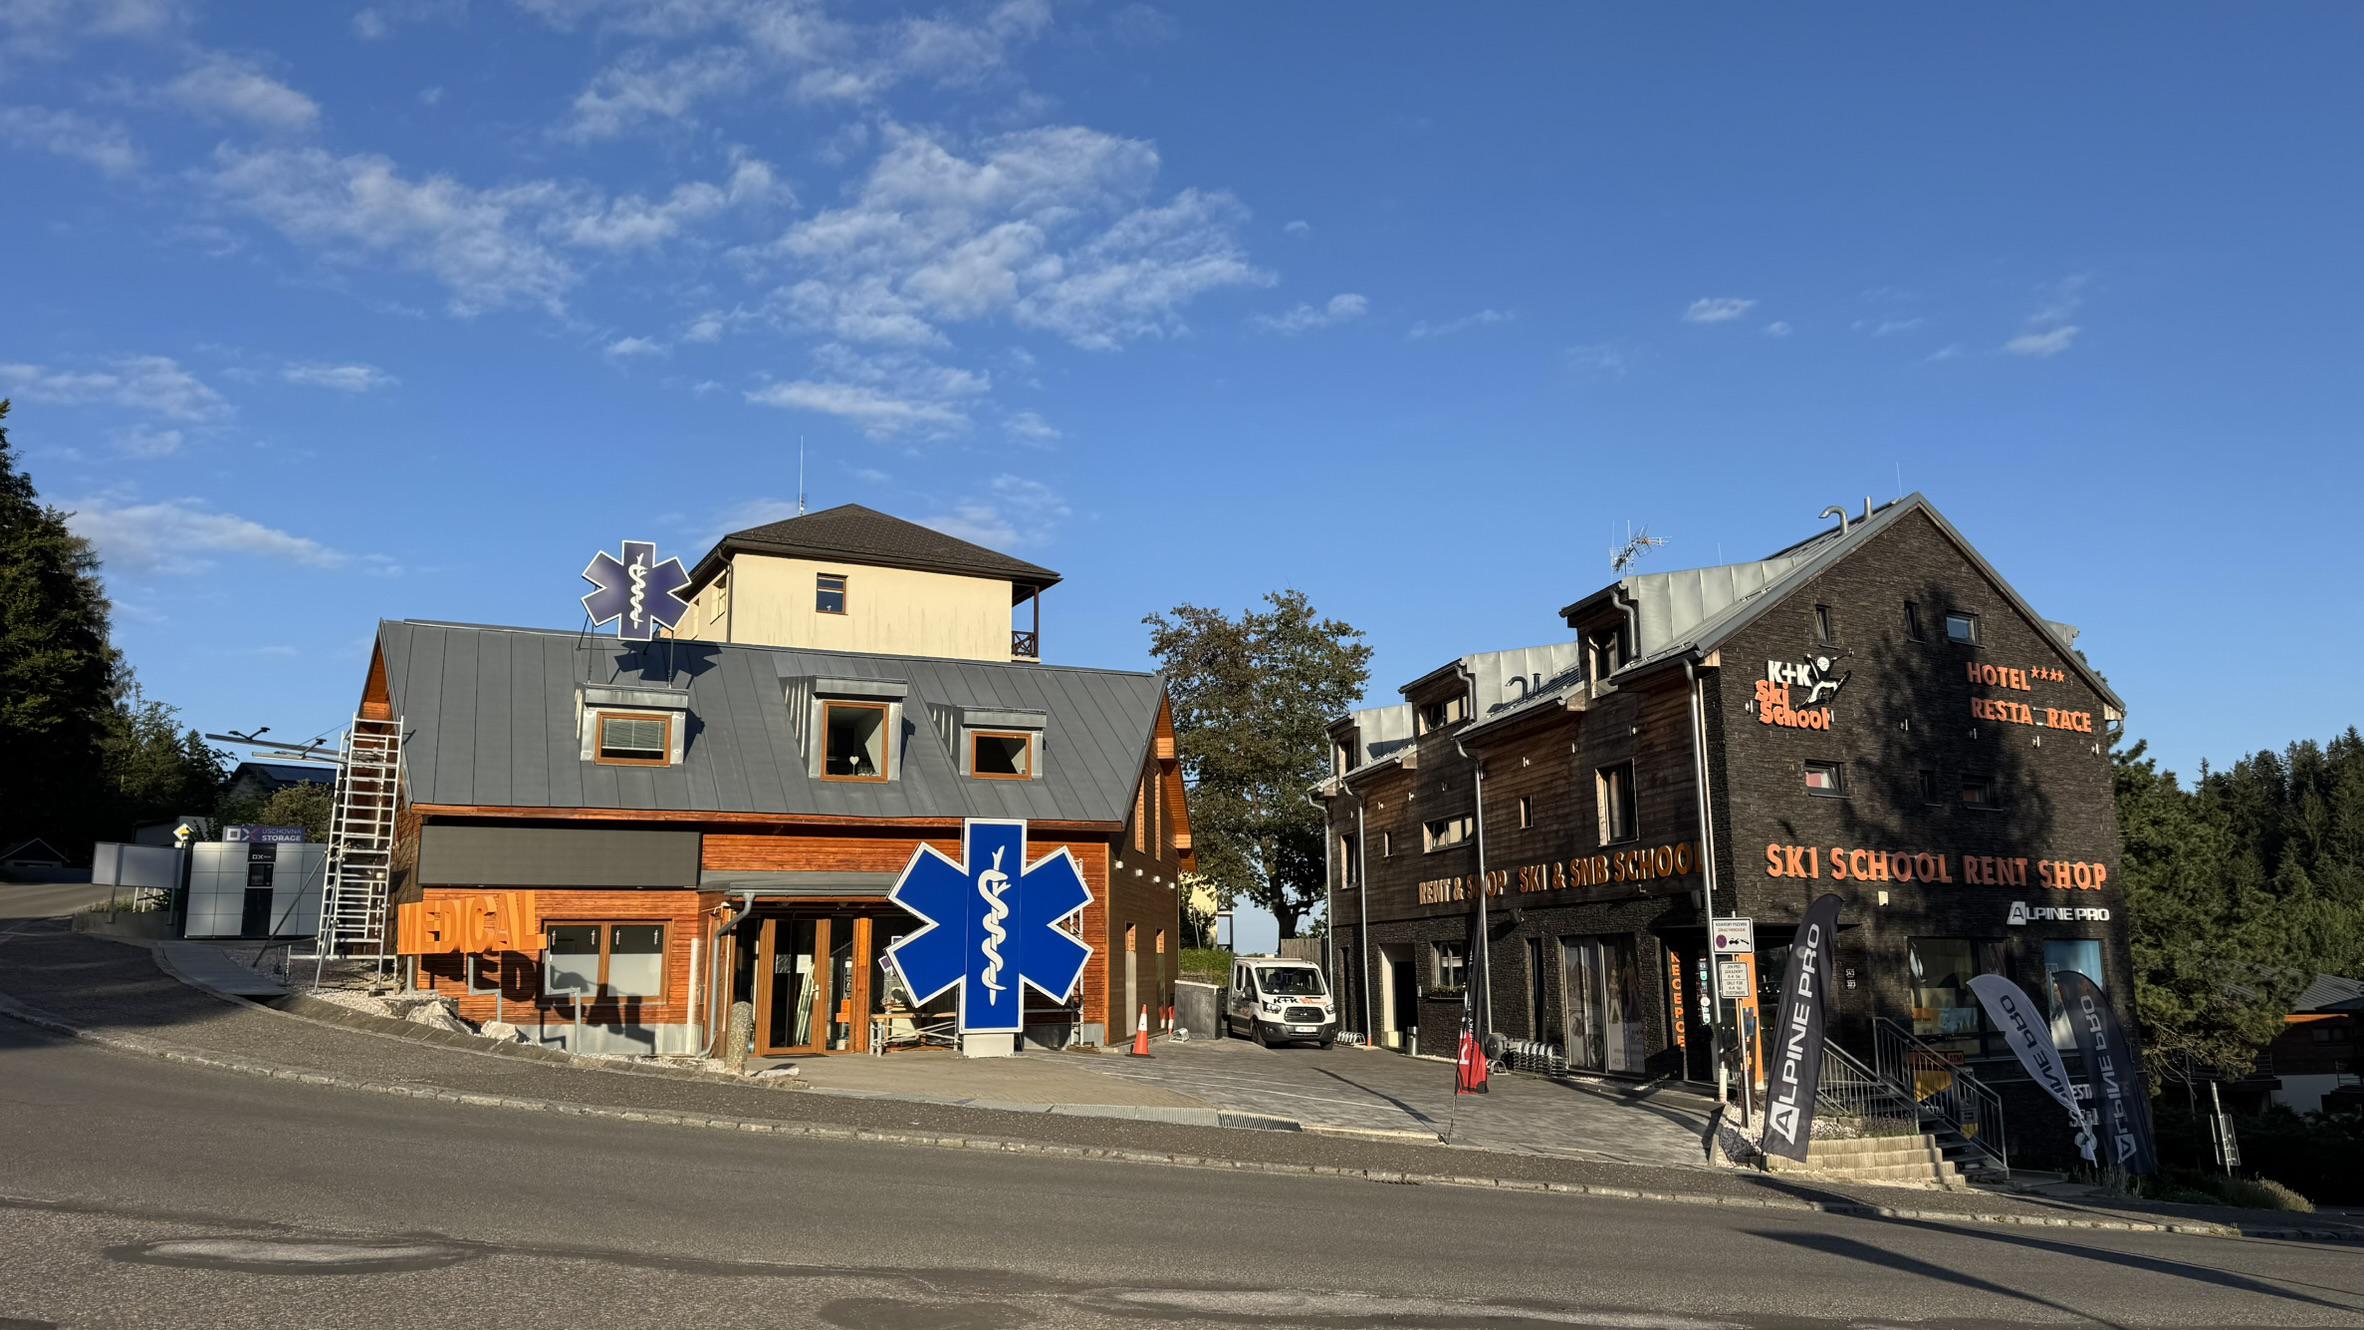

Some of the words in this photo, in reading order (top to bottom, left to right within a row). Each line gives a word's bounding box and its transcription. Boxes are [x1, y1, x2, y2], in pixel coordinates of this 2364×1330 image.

[1768, 660, 1812, 687] K+K
[1967, 662, 2031, 691] HOTEL
[1418, 878, 1451, 904] RENT
[1453, 877, 1464, 900] &
[1519, 864, 1548, 894] SKI
[1552, 862, 1566, 889] &
[1570, 855, 1609, 887] SNB
[1766, 844, 1819, 879] SKI
[1830, 848, 1952, 883] SCHOOL
[1963, 855, 2028, 886] RENT
[2039, 860, 2107, 890] SHOP
[2007, 901, 2074, 925] ALPINE
[2075, 908, 2110, 921] PRO
[1769, 1002, 1810, 1145] ALPINE
[1798, 923, 1820, 998] PRO
